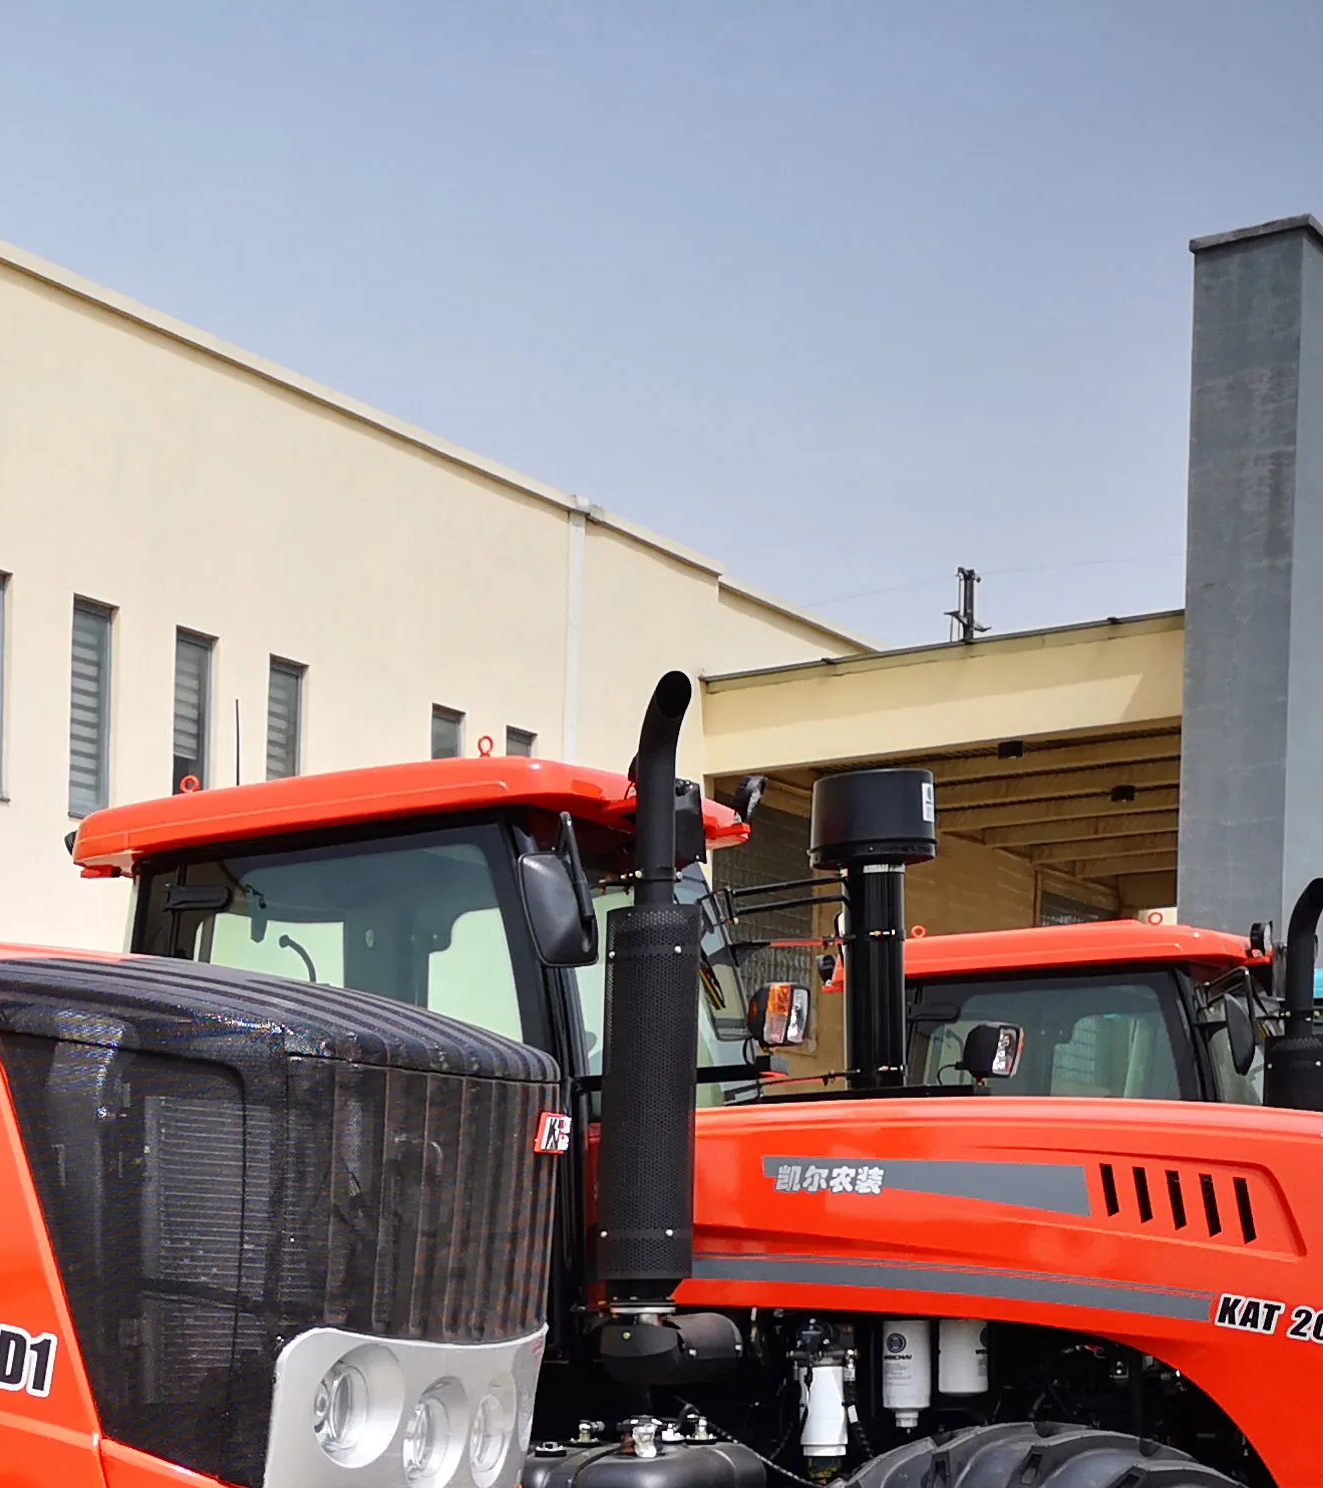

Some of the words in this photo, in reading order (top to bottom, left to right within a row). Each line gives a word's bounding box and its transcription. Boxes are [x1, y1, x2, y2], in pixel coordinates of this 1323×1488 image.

[774, 1164, 885, 1195] 凯尔农装
[1216, 1295, 1284, 1333] KAT
